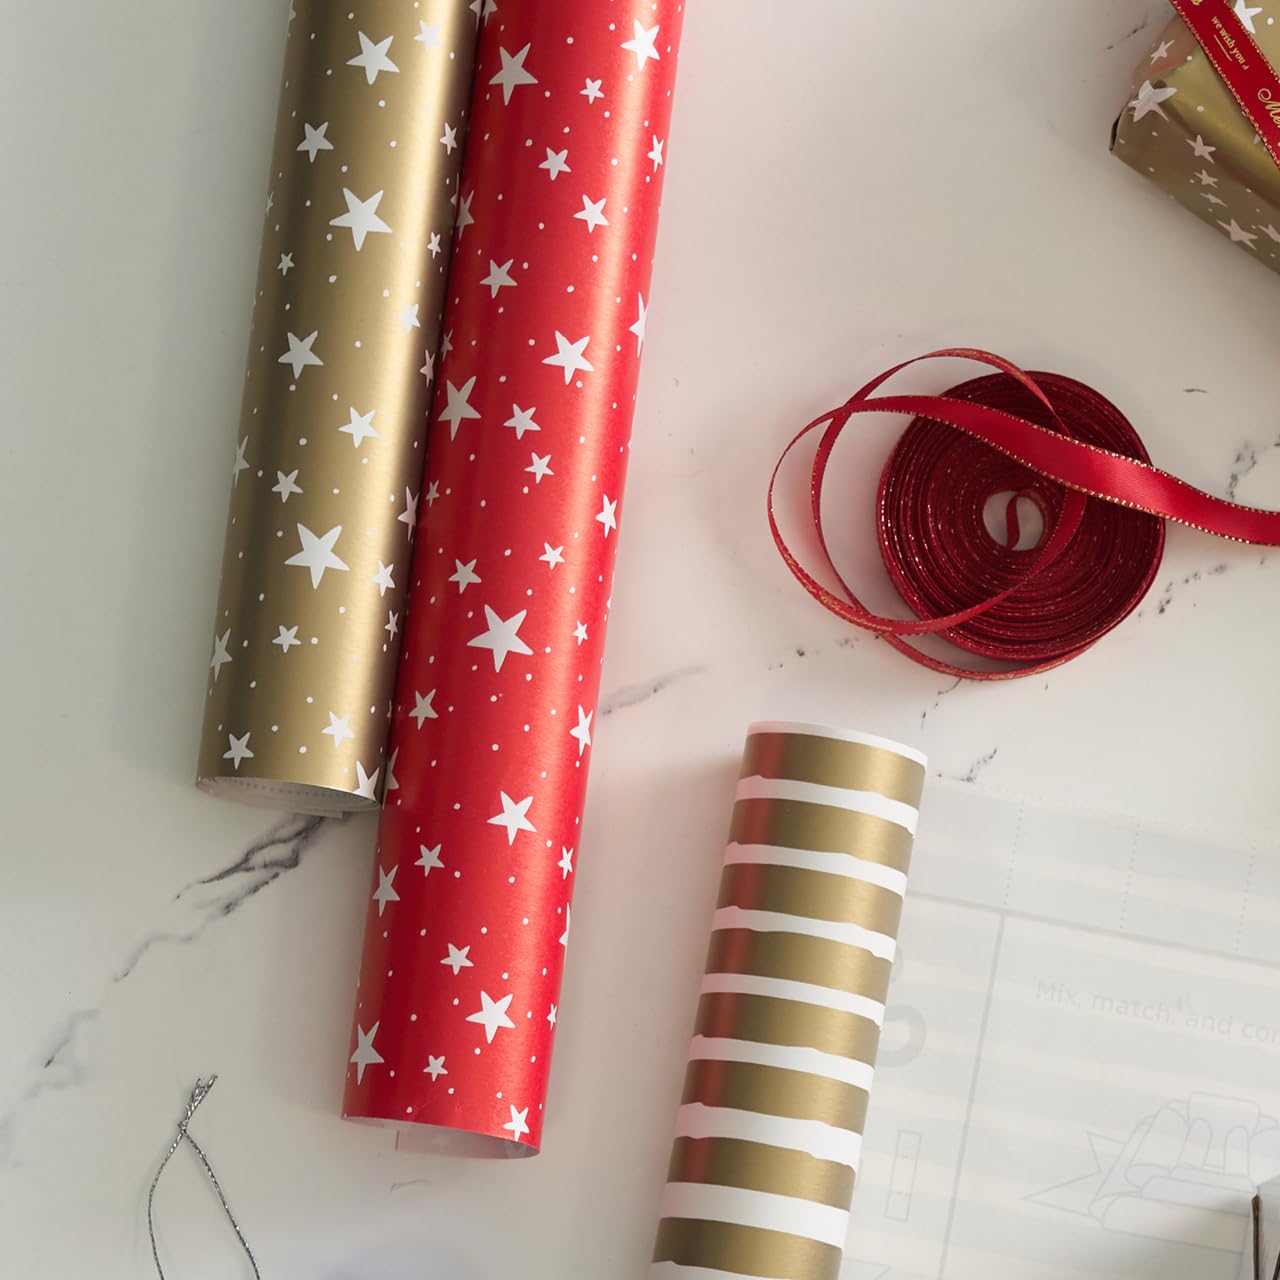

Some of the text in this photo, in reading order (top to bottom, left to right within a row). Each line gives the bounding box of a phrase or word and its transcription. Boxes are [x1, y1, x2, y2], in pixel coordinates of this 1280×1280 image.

[1219, 27, 1236, 49] wish
[1230, 47, 1246, 65] you
[1183, 1008, 1234, 1037] and
